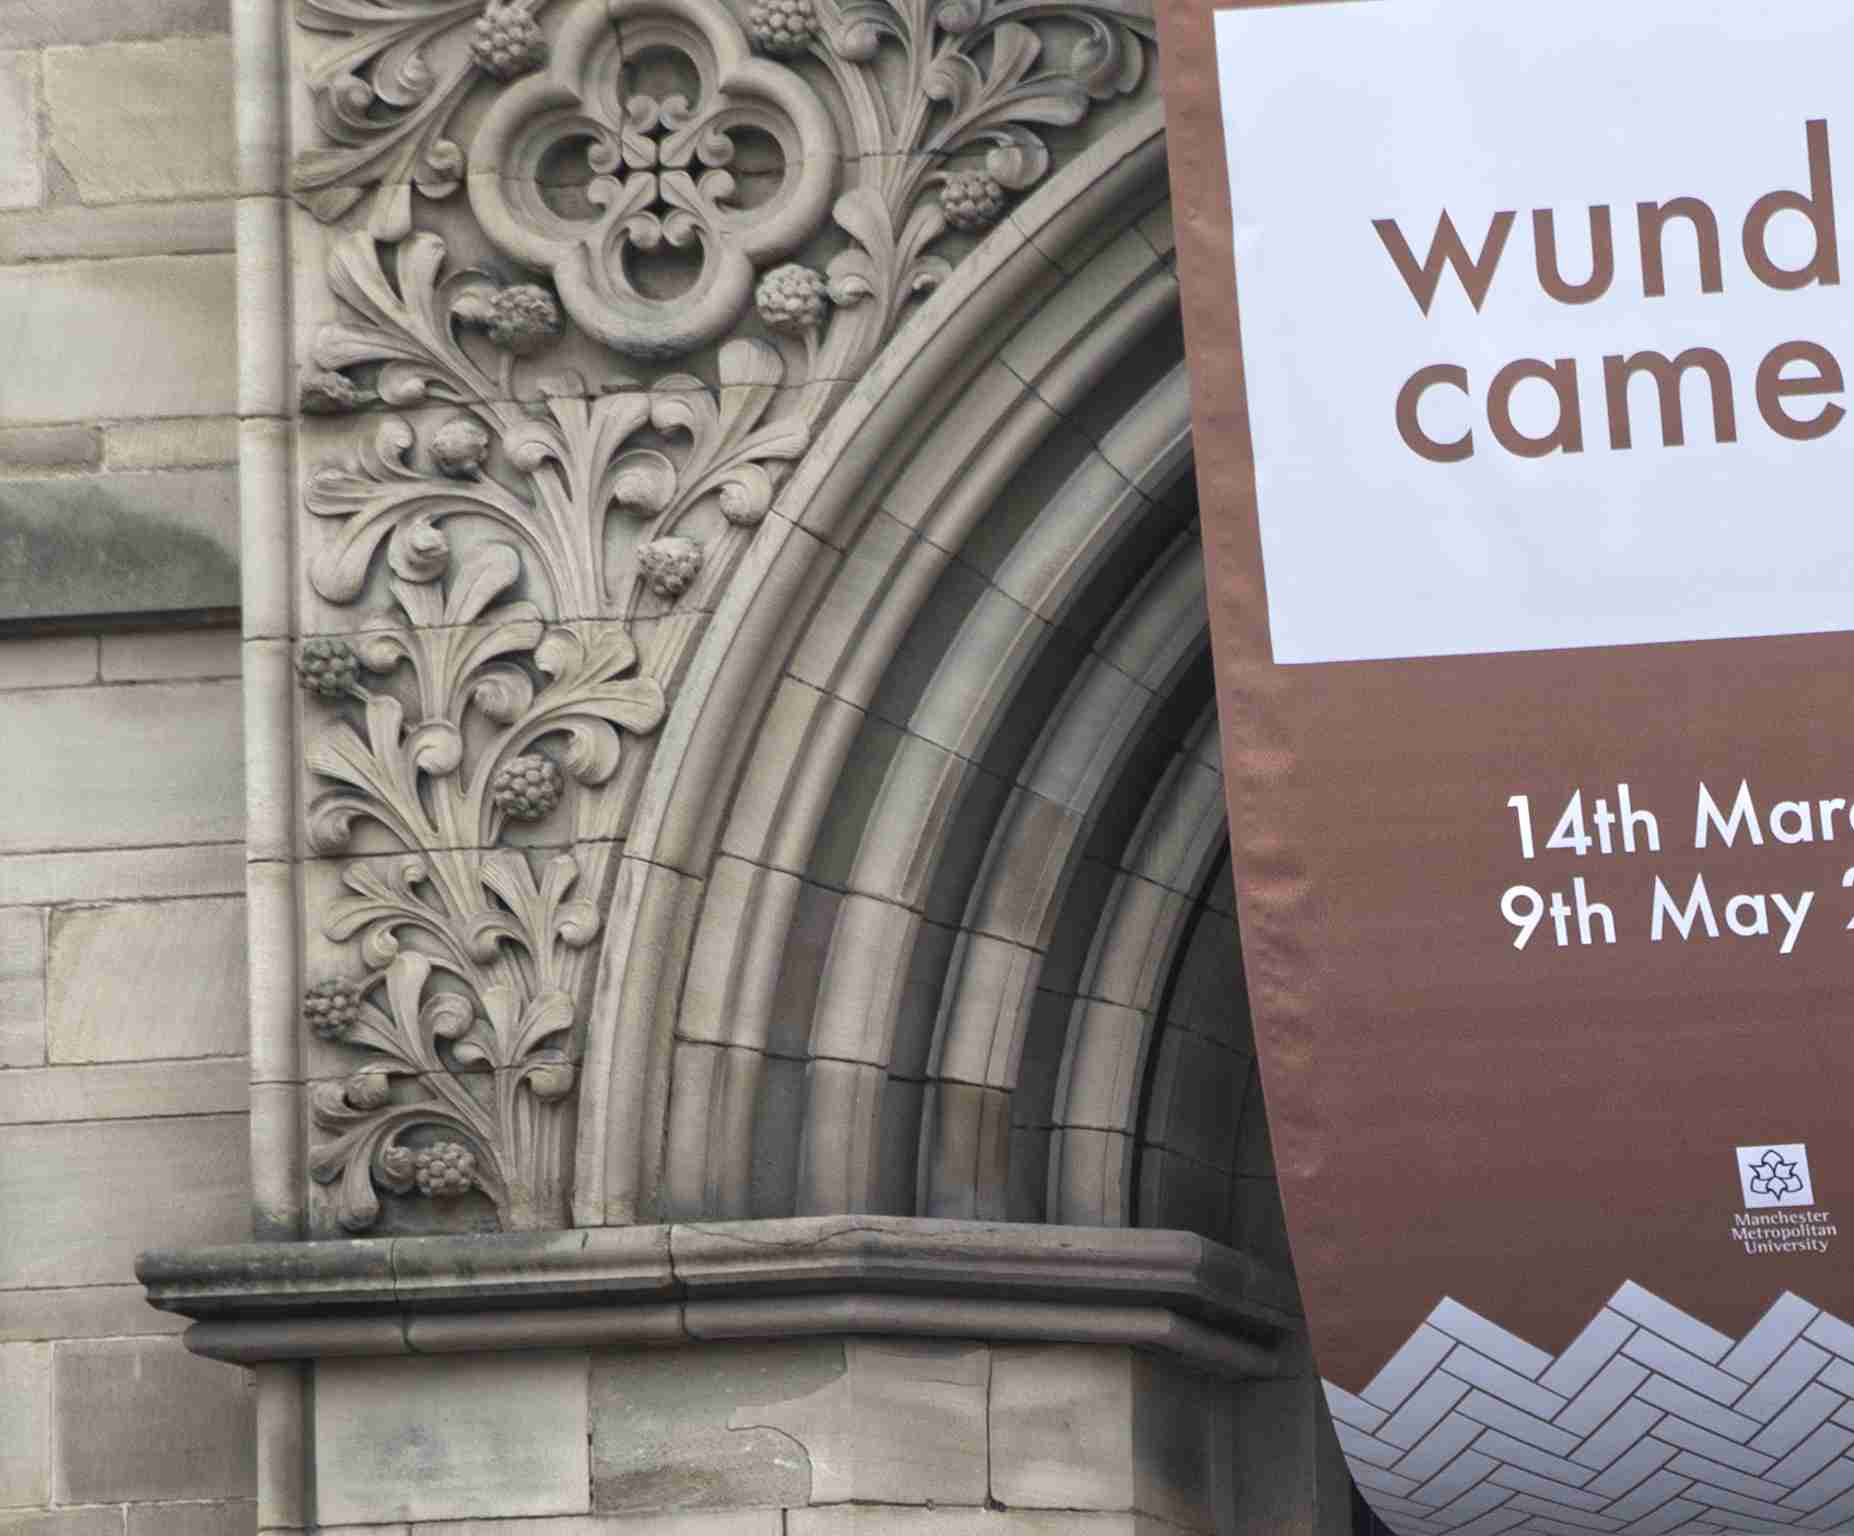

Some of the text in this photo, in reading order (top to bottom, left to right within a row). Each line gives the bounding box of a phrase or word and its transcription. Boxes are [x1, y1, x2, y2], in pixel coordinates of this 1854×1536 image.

[1507, 783, 1660, 859] 14th
[1500, 876, 1617, 951] 9th
[1650, 872, 1815, 954] May
[1733, 1210, 1831, 1226] Manchester
[1731, 1224, 1838, 1241] Metropolitan
[1744, 1238, 1830, 1254] University
